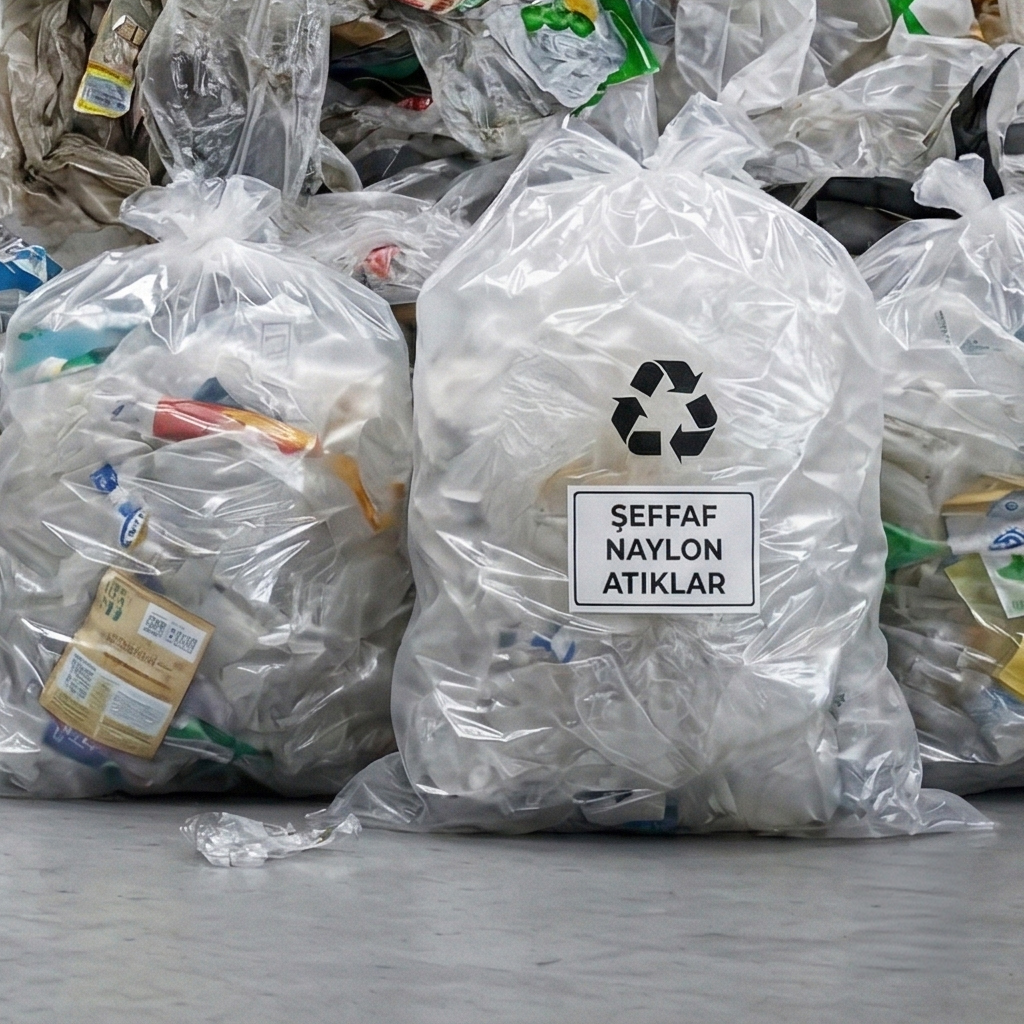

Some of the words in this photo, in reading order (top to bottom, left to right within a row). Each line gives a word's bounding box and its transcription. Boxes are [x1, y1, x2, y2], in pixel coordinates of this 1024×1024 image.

[611, 504, 717, 533] ŞEFFAF
[606, 538, 722, 561] NAYLON
[602, 572, 726, 595] ATIKLAR
